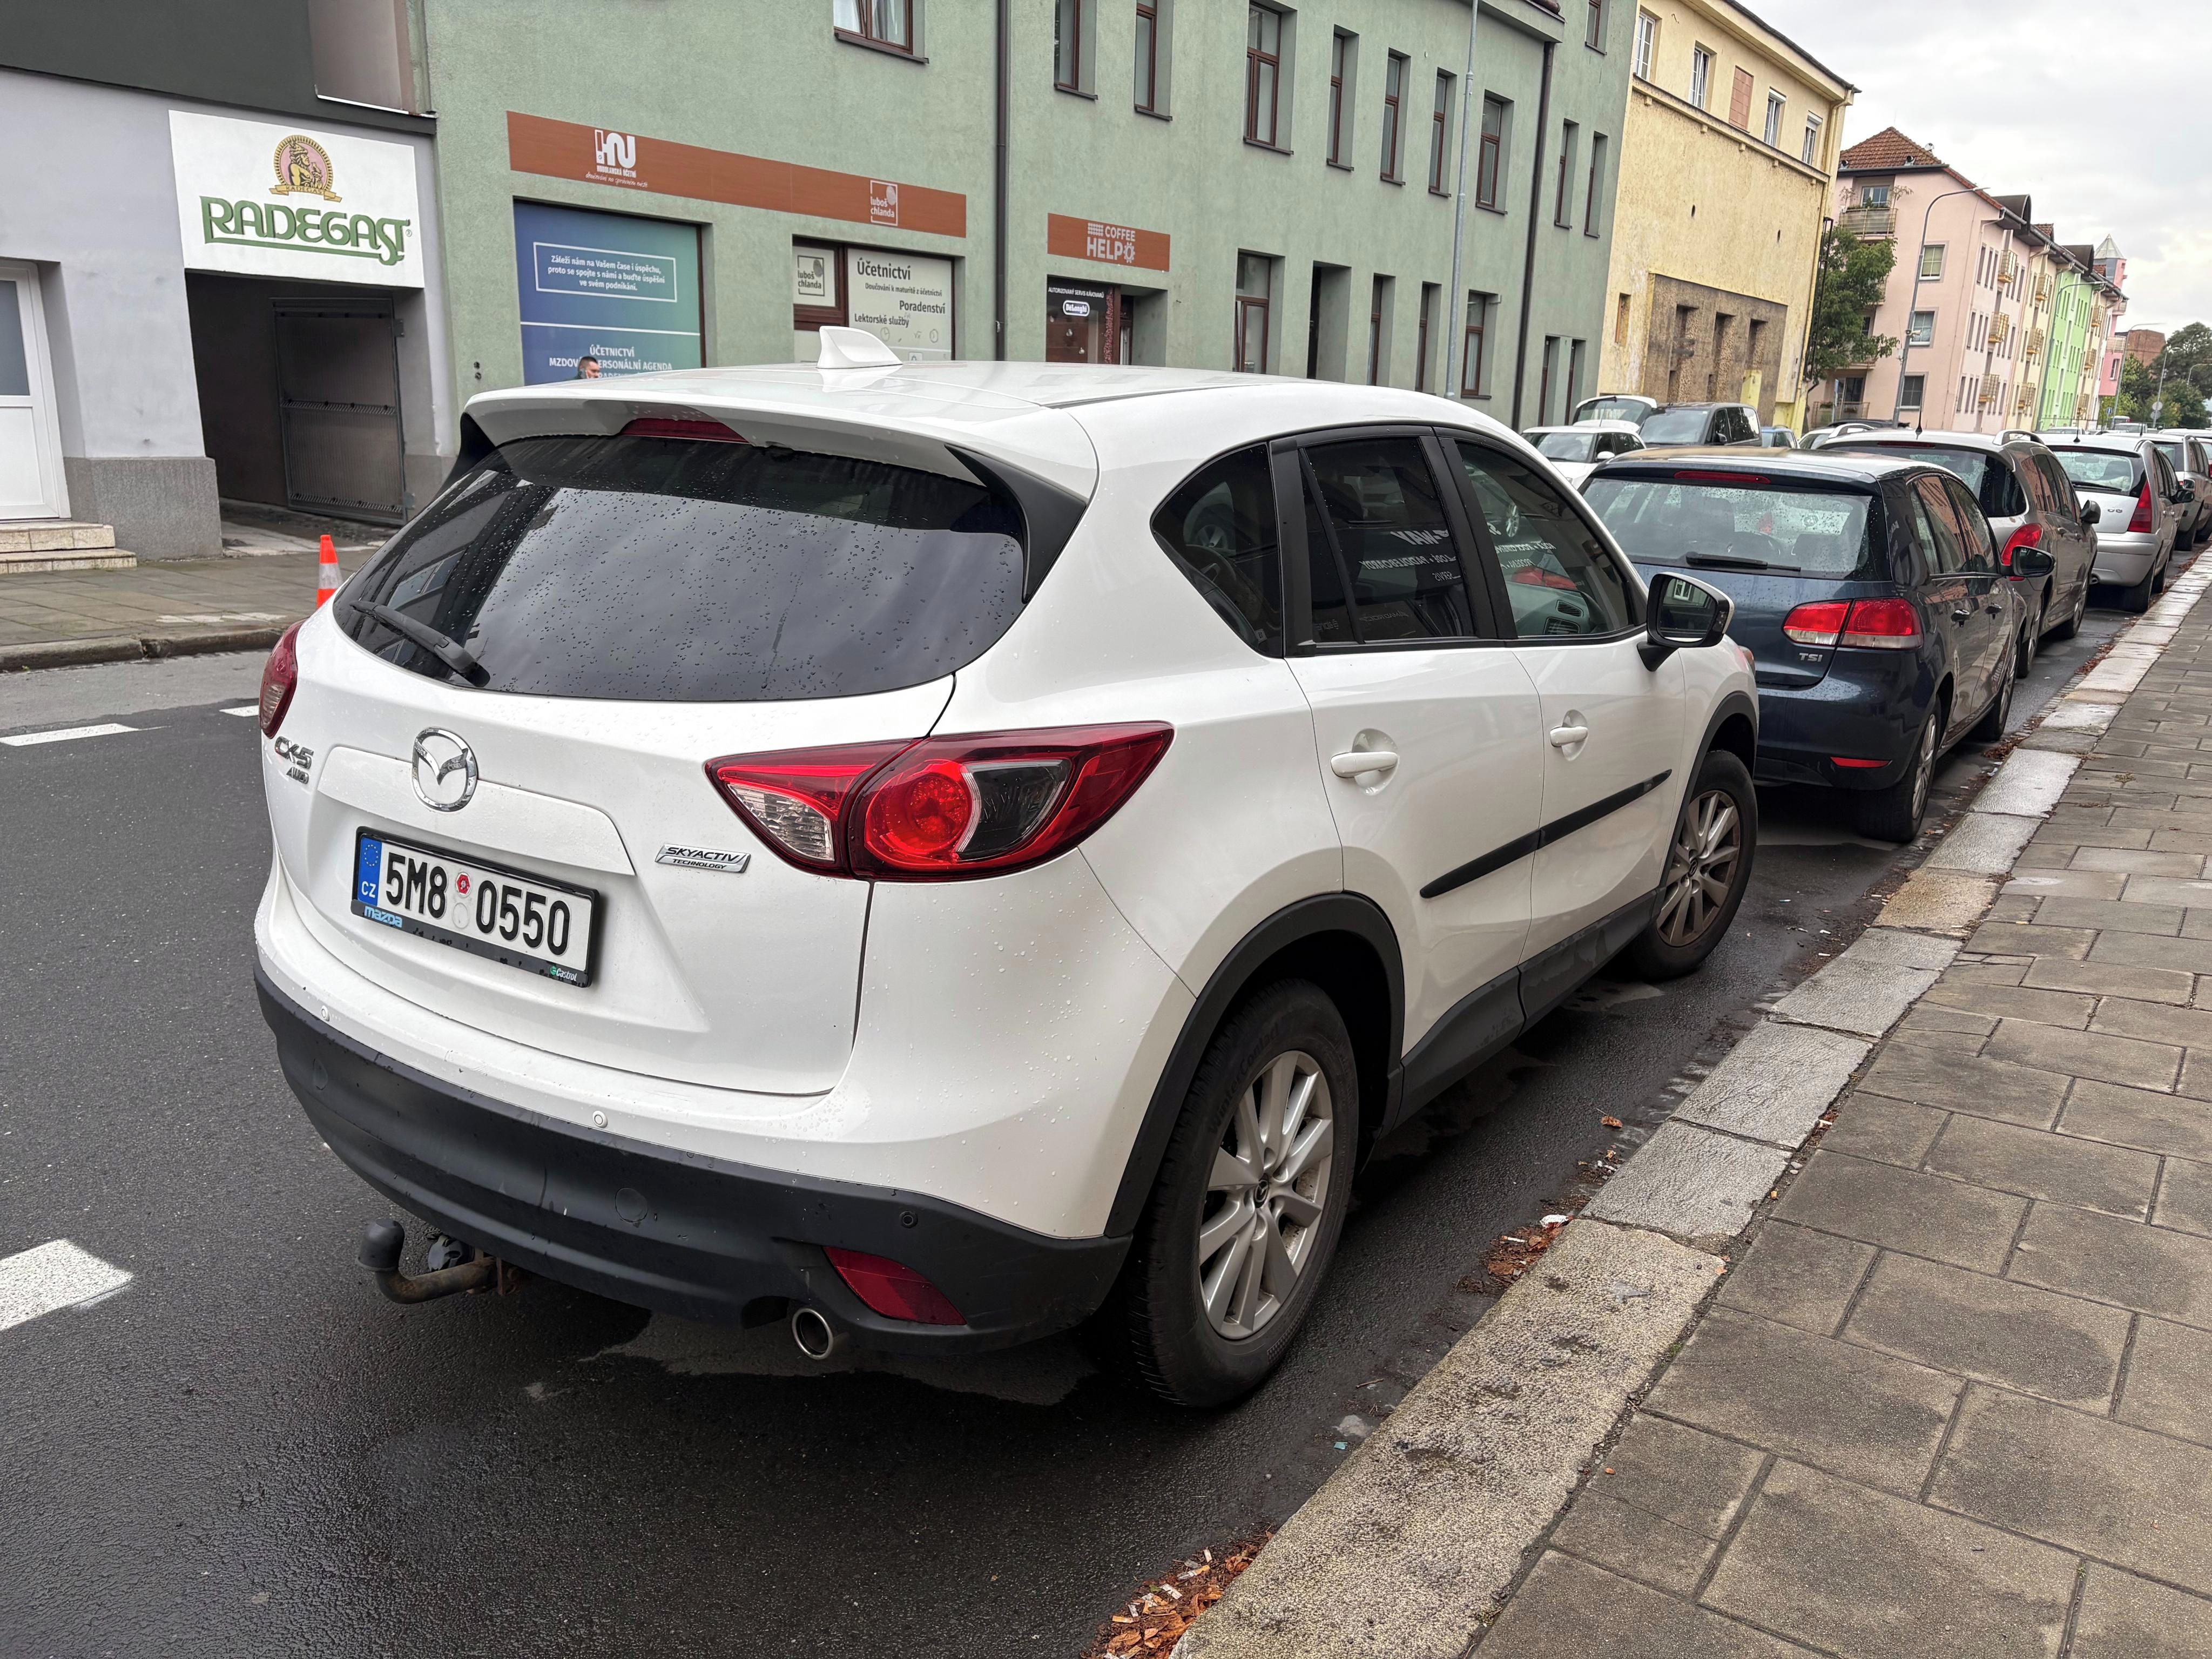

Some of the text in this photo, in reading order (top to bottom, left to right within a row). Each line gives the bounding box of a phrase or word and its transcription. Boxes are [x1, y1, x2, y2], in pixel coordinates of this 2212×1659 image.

[870, 196, 888, 207] luboš
[871, 206, 895, 218] chlanda
[199, 195, 410, 266] RADEGAST
[1105, 226, 1136, 242] COFFEE
[551, 255, 571, 264] Záleží
[571, 257, 585, 266] nám
[595, 259, 616, 269] Vašem
[617, 261, 630, 271] čase
[635, 264, 661, 274] úspěchu,
[857, 257, 911, 280] Účetnictví
[576, 269, 596, 278] spojte
[602, 271, 617, 279] námi
[623, 273, 641, 281] buďte
[642, 274, 665, 284] úspěšní
[798, 270, 814, 280] luboš
[605, 281, 638, 291] podnikání.
[798, 280, 821, 289] chlanda
[865, 282, 891, 292] Doučování
[895, 286, 915, 294] maturitě
[920, 288, 942, 297] účetnictví
[899, 300, 945, 314] Poradenství
[854, 313, 909, 328] Lektorské služby
[590, 345, 635, 357] ÚČETNICTVÍ
[598, 359, 641, 370] ERSONÁLNÍ
[643, 361, 672, 370] AGENDA
[1799, 652, 1823, 662] TSI
[286, 767, 309, 785] AWD
[665, 847, 740, 862] SKYACTIV
[673, 859, 727, 869] TECHNOLOGY
[361, 881, 376, 899] CZ
[386, 852, 570, 955] 5M8 0550
[556, 968, 577, 981] Castrol
